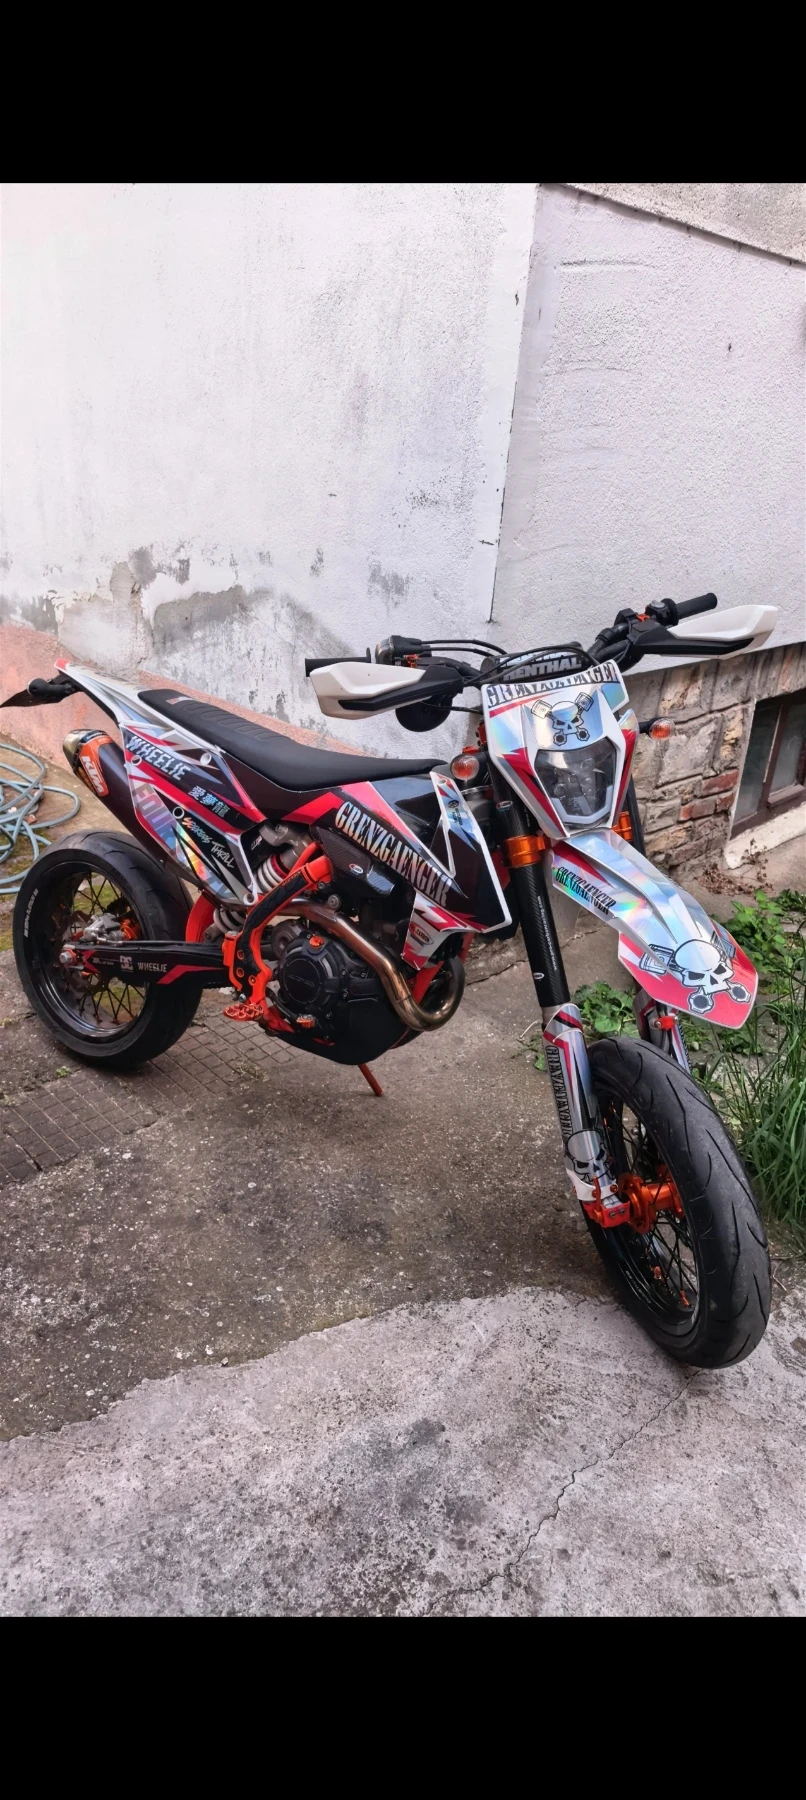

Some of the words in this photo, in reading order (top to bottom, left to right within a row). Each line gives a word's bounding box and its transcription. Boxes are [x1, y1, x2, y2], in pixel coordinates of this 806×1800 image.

[503, 657, 581, 681] RENTHAL
[126, 736, 190, 780] WHEELIE
[81, 756, 105, 792] KTM
[335, 801, 453, 907] GRENZGAENGER
[120, 955, 133, 970] DC
[137, 962, 168, 973] WHEELIE
